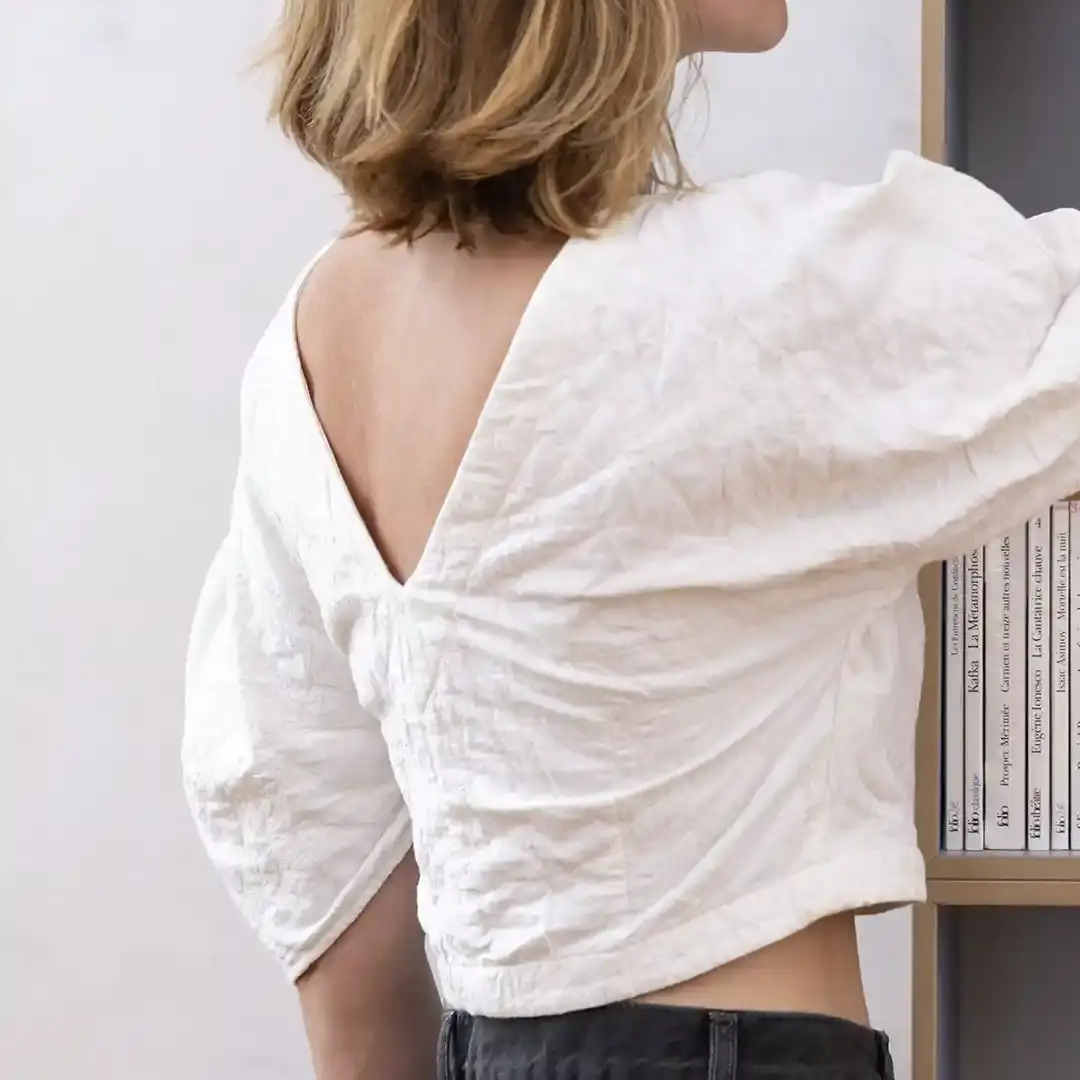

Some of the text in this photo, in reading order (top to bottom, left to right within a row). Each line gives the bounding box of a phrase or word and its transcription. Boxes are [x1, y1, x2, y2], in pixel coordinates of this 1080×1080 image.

[967, 549, 983, 649] La Métamorphos
[1000, 536, 1011, 693] Carmen treize autres nouvelles
[1031, 545, 1043, 658] La Cantatrice chauve
[1056, 532, 1067, 620] Mortelle nuit
[968, 660, 980, 693] Kafka
[1056, 629, 1067, 693] Isaac Asimov
[999, 704, 1013, 786] Prosper Mérimée
[1031, 669, 1045, 754] Eugène Ionesco
[996, 805, 1010, 827] folio
